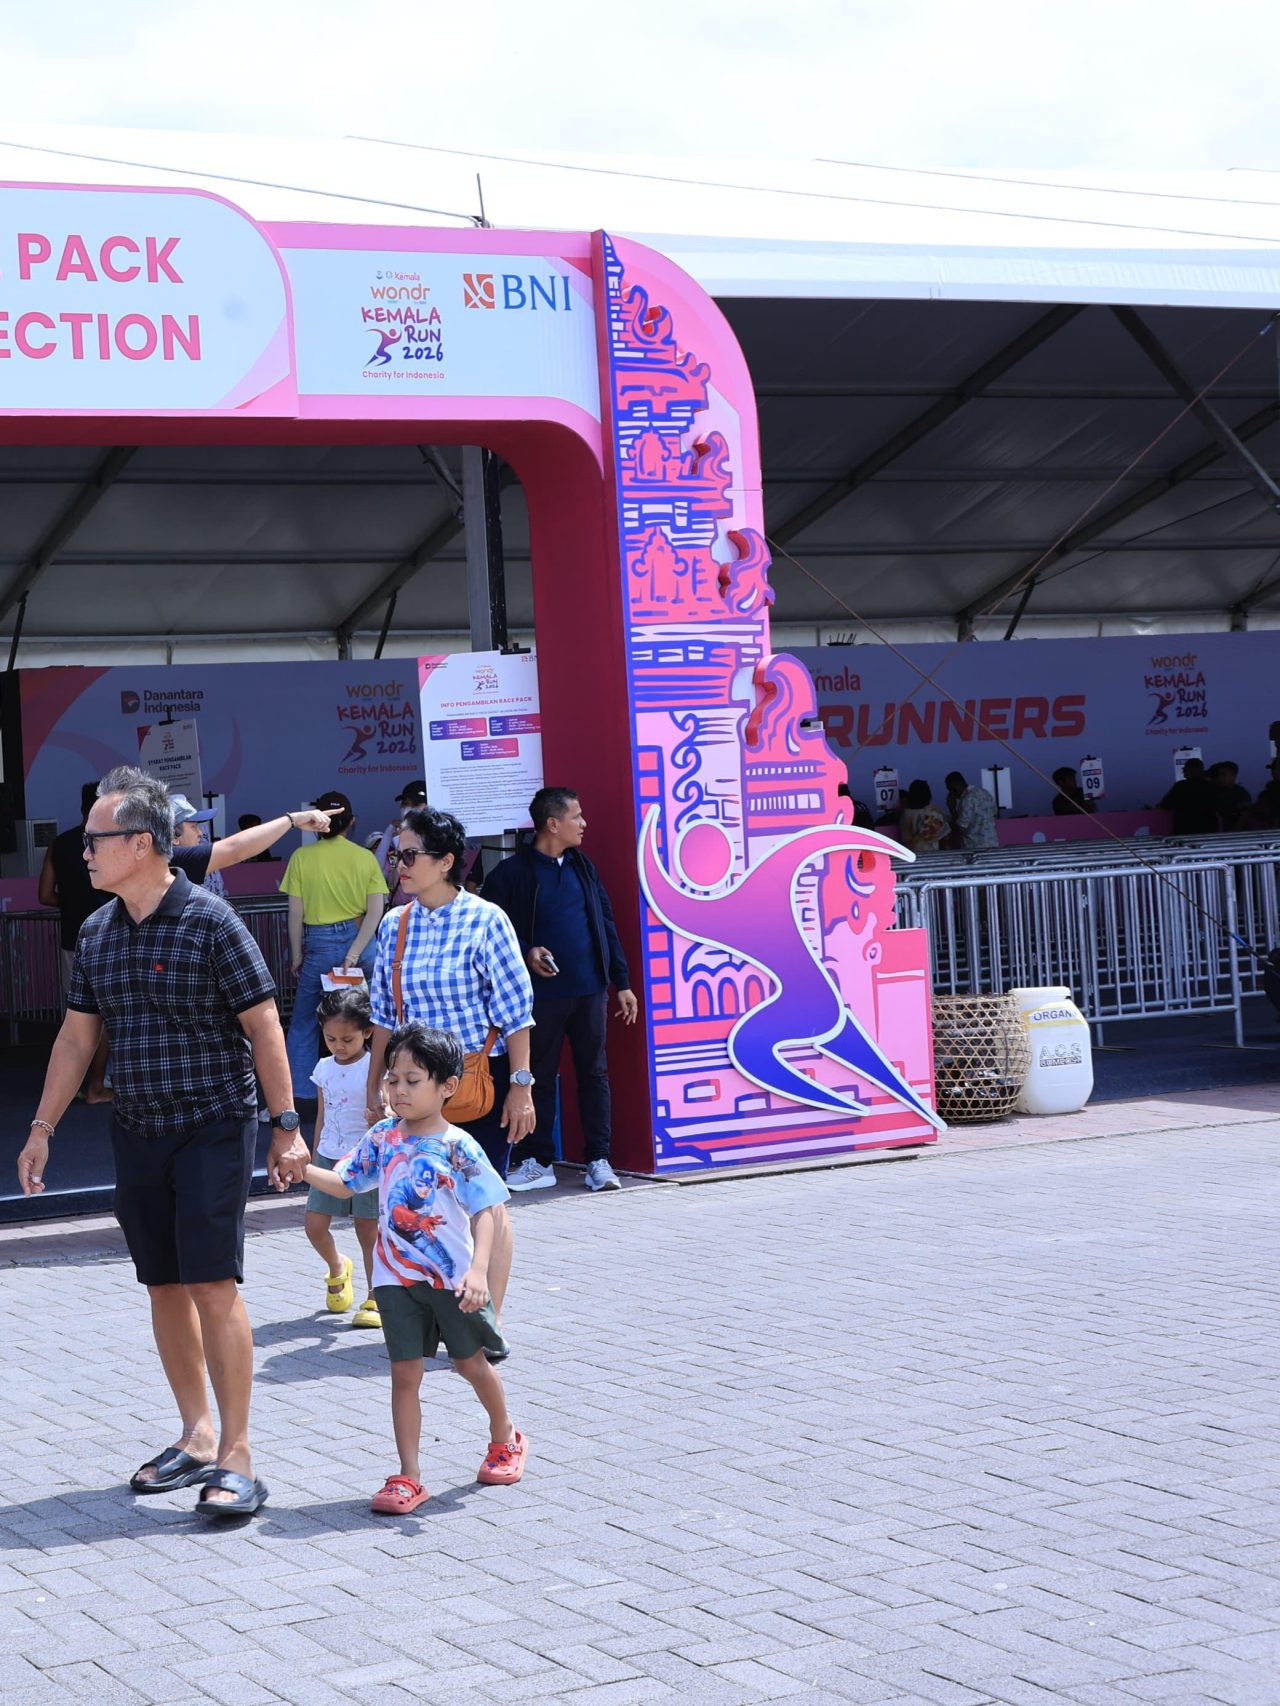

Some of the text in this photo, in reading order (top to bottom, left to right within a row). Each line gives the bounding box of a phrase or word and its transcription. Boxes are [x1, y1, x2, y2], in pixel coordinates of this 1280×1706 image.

[17, 232, 185, 285] PACK
[370, 283, 430, 300] wondr
[502, 274, 573, 311] BNI
[361, 306, 441, 325] KEMALA
[404, 325, 441, 344] RUN
[402, 342, 444, 362] 2026
[362, 370, 392, 380] Charity
[405, 371, 445, 379] Indonesia
[1151, 651, 1197, 668] wondr
[815, 665, 862, 691] mala
[1144, 671, 1206, 688] KEMALA
[143, 689, 204, 700] Danantara
[345, 680, 405, 698] wondr
[1177, 688, 1206, 704] RUN
[144, 701, 201, 713] Indonesia
[336, 701, 415, 721] KEMALA
[1175, 701, 1208, 718] 2026
[378, 720, 414, 738] RUN
[817, 695, 1087, 747] RUNNERS
[376, 735, 417, 754] 2026
[337, 765, 368, 775] Charity
[1086, 777, 1100, 789] 09
[880, 789, 894, 801] 07
